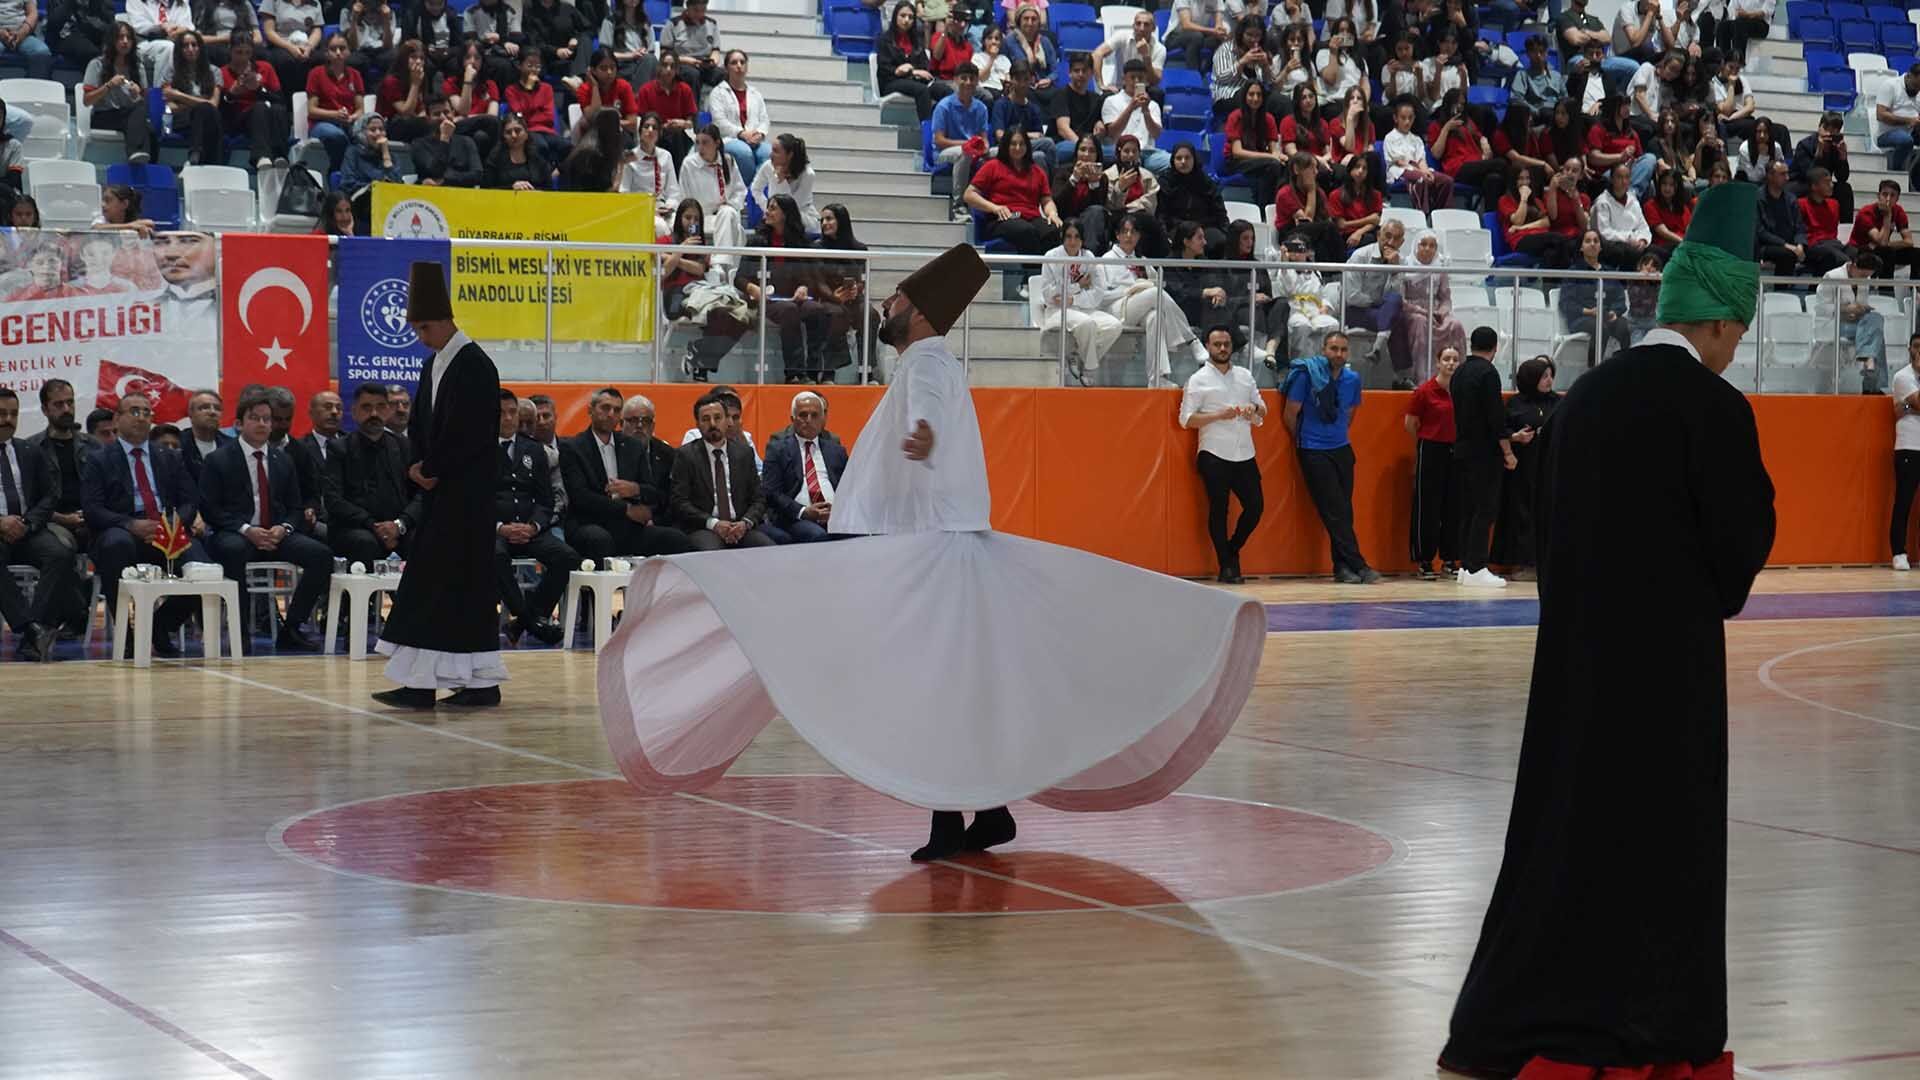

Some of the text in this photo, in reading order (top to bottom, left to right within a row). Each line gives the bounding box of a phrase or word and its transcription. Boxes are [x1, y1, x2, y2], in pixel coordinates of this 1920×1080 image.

[456, 251, 505, 274] BİSMİL
[574, 258, 592, 276] VE
[594, 255, 647, 277] TEKNİK
[457, 283, 525, 303] ANADOLU
[63, 353, 83, 368] VE
[347, 354, 424, 370] T.C. GENÇLİK
[347, 368, 421, 382] SPOR BAKAN
